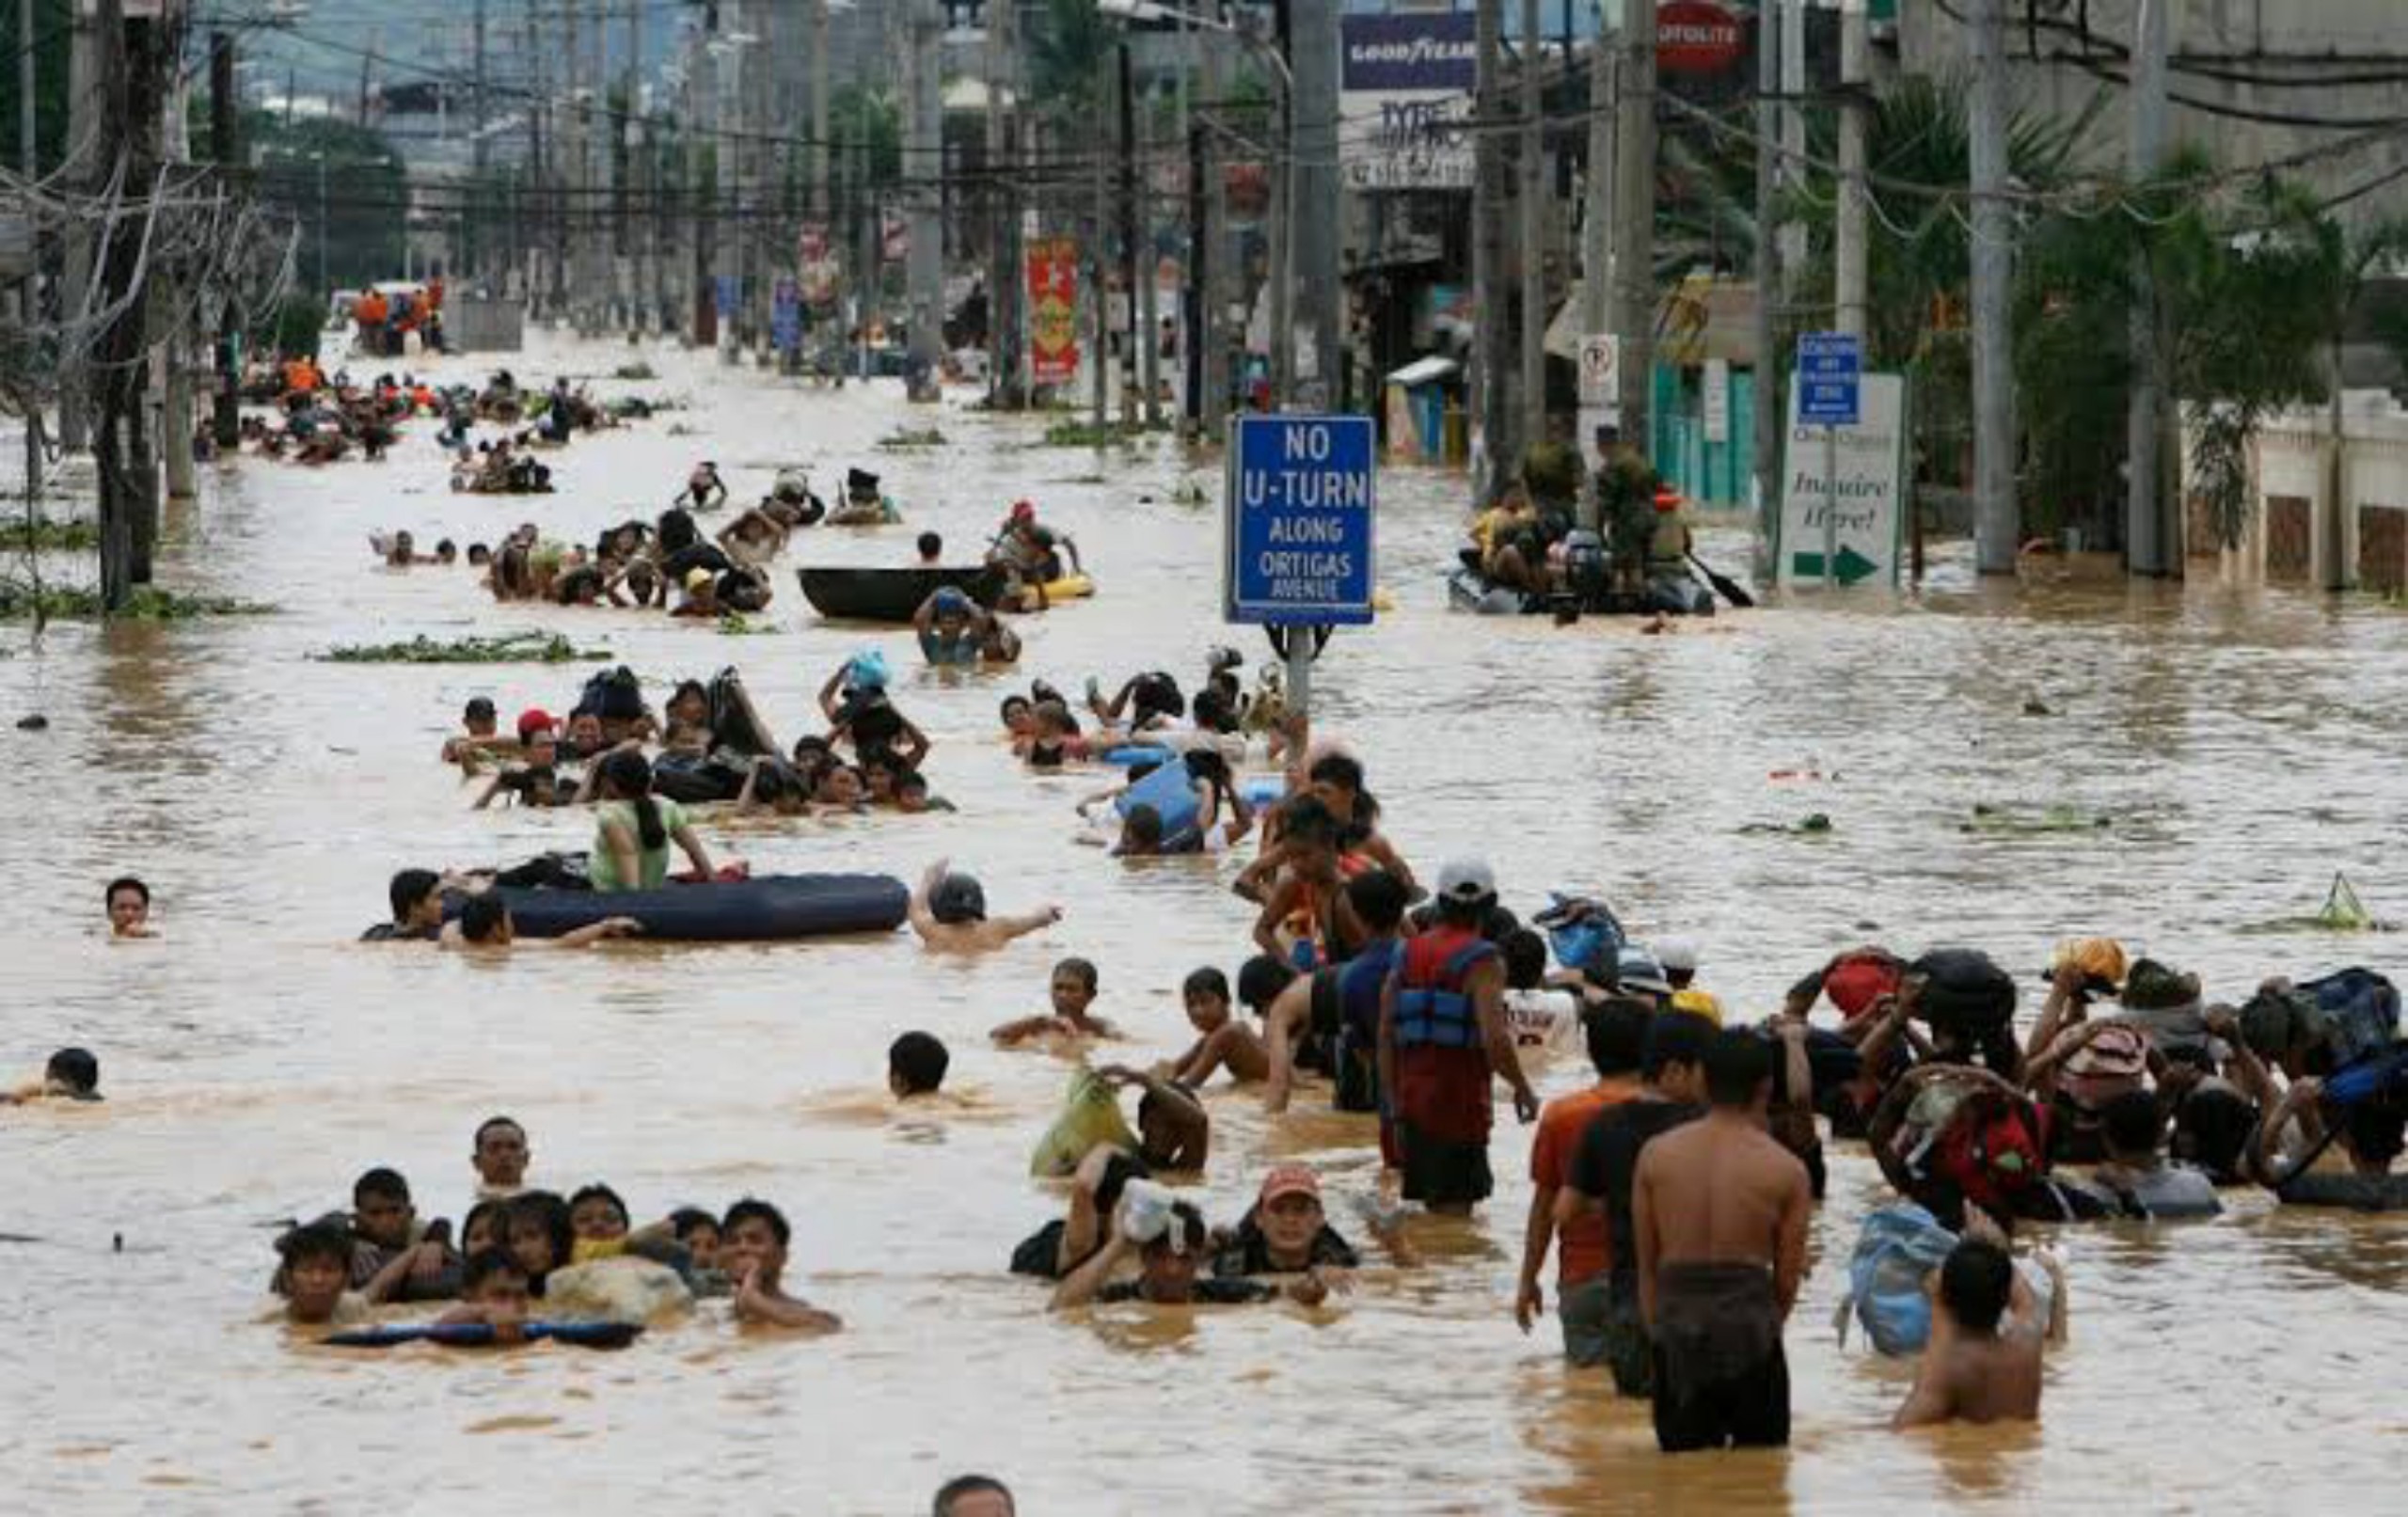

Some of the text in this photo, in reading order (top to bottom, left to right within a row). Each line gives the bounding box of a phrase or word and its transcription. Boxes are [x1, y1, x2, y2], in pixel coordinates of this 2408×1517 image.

[1658, 25, 1735, 43] OTOLITE
[1352, 38, 1475, 65] GOODYEAR
[1286, 425, 1330, 460] NO
[1245, 470, 1367, 507] U-TURN
[1270, 517, 1342, 542] ALONG
[1804, 508, 1876, 529] Hre!
[1259, 551, 1352, 577] ORTIGAS
[1272, 578, 1339, 598] AVENUE
